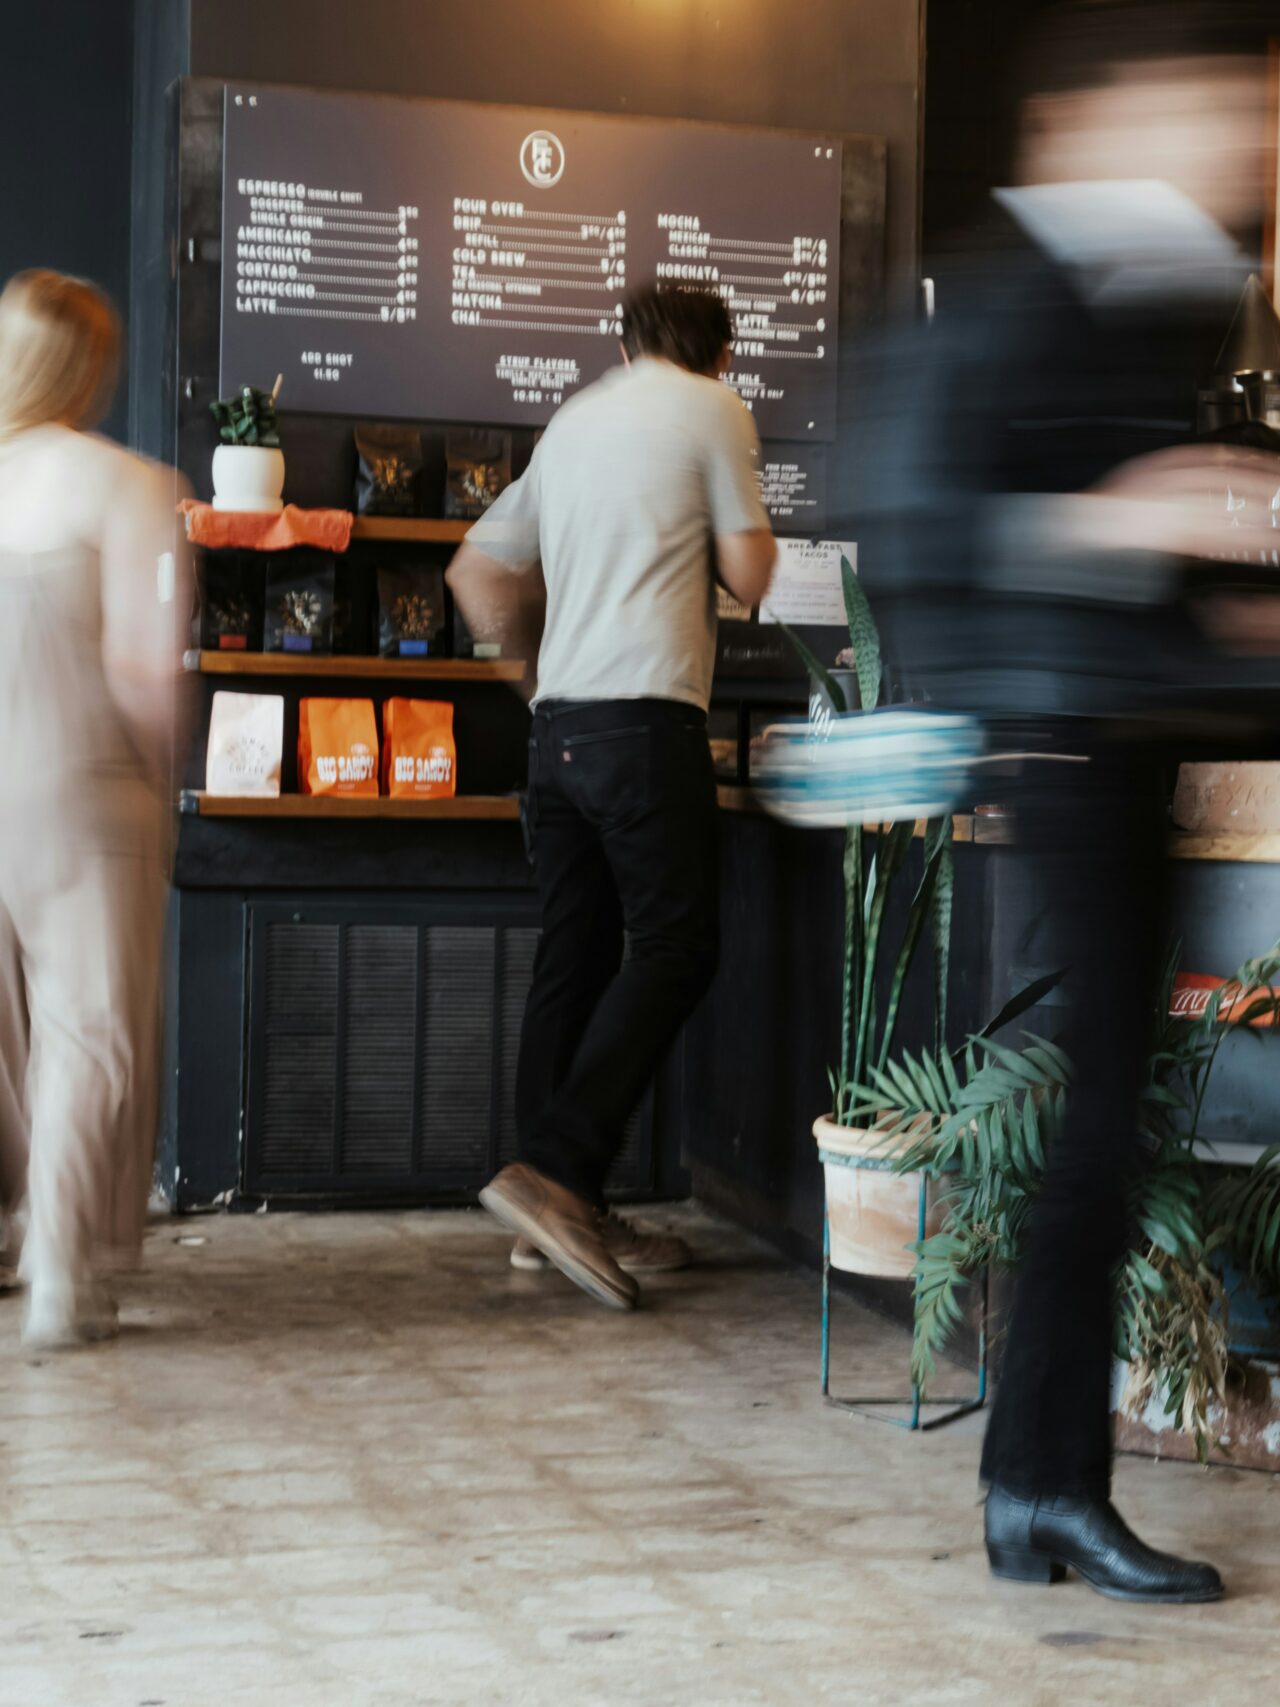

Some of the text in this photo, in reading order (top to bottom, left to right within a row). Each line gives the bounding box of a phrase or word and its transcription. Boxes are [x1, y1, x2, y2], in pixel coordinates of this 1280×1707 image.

[238, 178, 306, 199] ESPRESSO
[453, 197, 487, 215] POUR
[491, 200, 524, 218] OVER
[250, 211, 287, 226] SINGLE
[289, 214, 323, 229] ORIGIN
[453, 215, 481, 232] DRIP
[657, 213, 700, 231] MOCHA
[237, 225, 311, 246] AMERICANO
[465, 232, 499, 249] REFILL
[668, 230, 711, 245] MEXICAN
[237, 243, 311, 264] MACCHIATO
[452, 247, 486, 265] COLD
[491, 250, 526, 267] BREW
[668, 244, 708, 259] CLASSIC
[237, 261, 297, 280] CORTADO
[452, 264, 476, 280] TEA
[656, 262, 719, 280] HORCHATA
[236, 279, 315, 299] CAPPUCCINO
[236, 296, 277, 315] LATTE
[452, 292, 502, 310] MATCHA
[451, 309, 480, 326] CHAI
[735, 313, 825, 332] LATTE 6
[301, 351, 353, 368] ADD SHOT
[817, 345, 825, 359] 3
[500, 354, 576, 371] SYRUP FLAVORS
[738, 373, 760, 387] MILK
[787, 543, 841, 551] BREAFAST
[800, 551, 829, 559] TACOS
[316, 755, 374, 784] BIG SANDY
[395, 756, 452, 783] BIG SANDY
